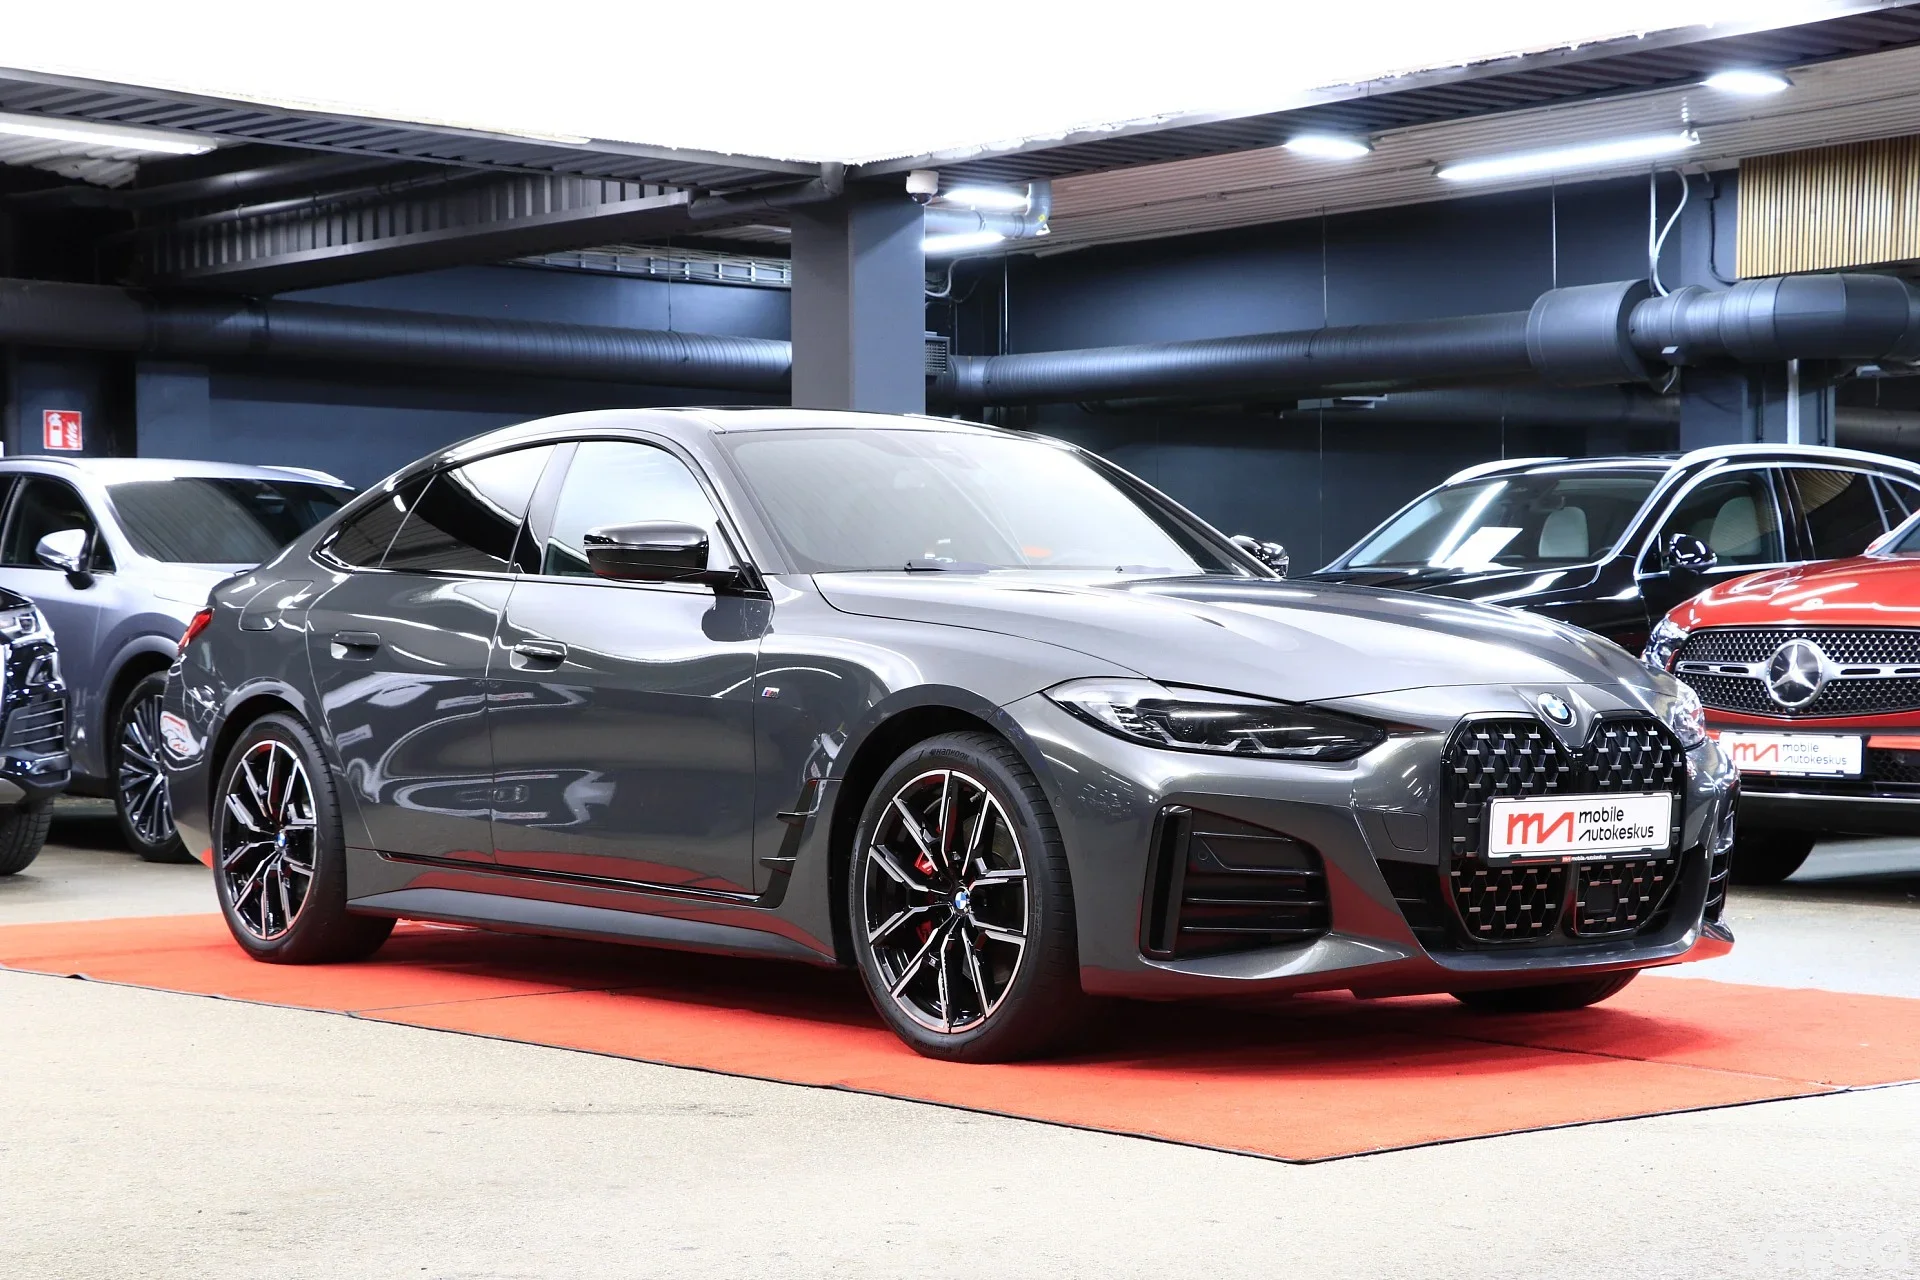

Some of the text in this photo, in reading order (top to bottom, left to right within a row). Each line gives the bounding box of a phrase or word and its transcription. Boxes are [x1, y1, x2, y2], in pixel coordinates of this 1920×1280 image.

[1782, 742, 1820, 753] mobile
[1578, 806, 1625, 824] mobile
[1578, 823, 1655, 842] Autokeskus
